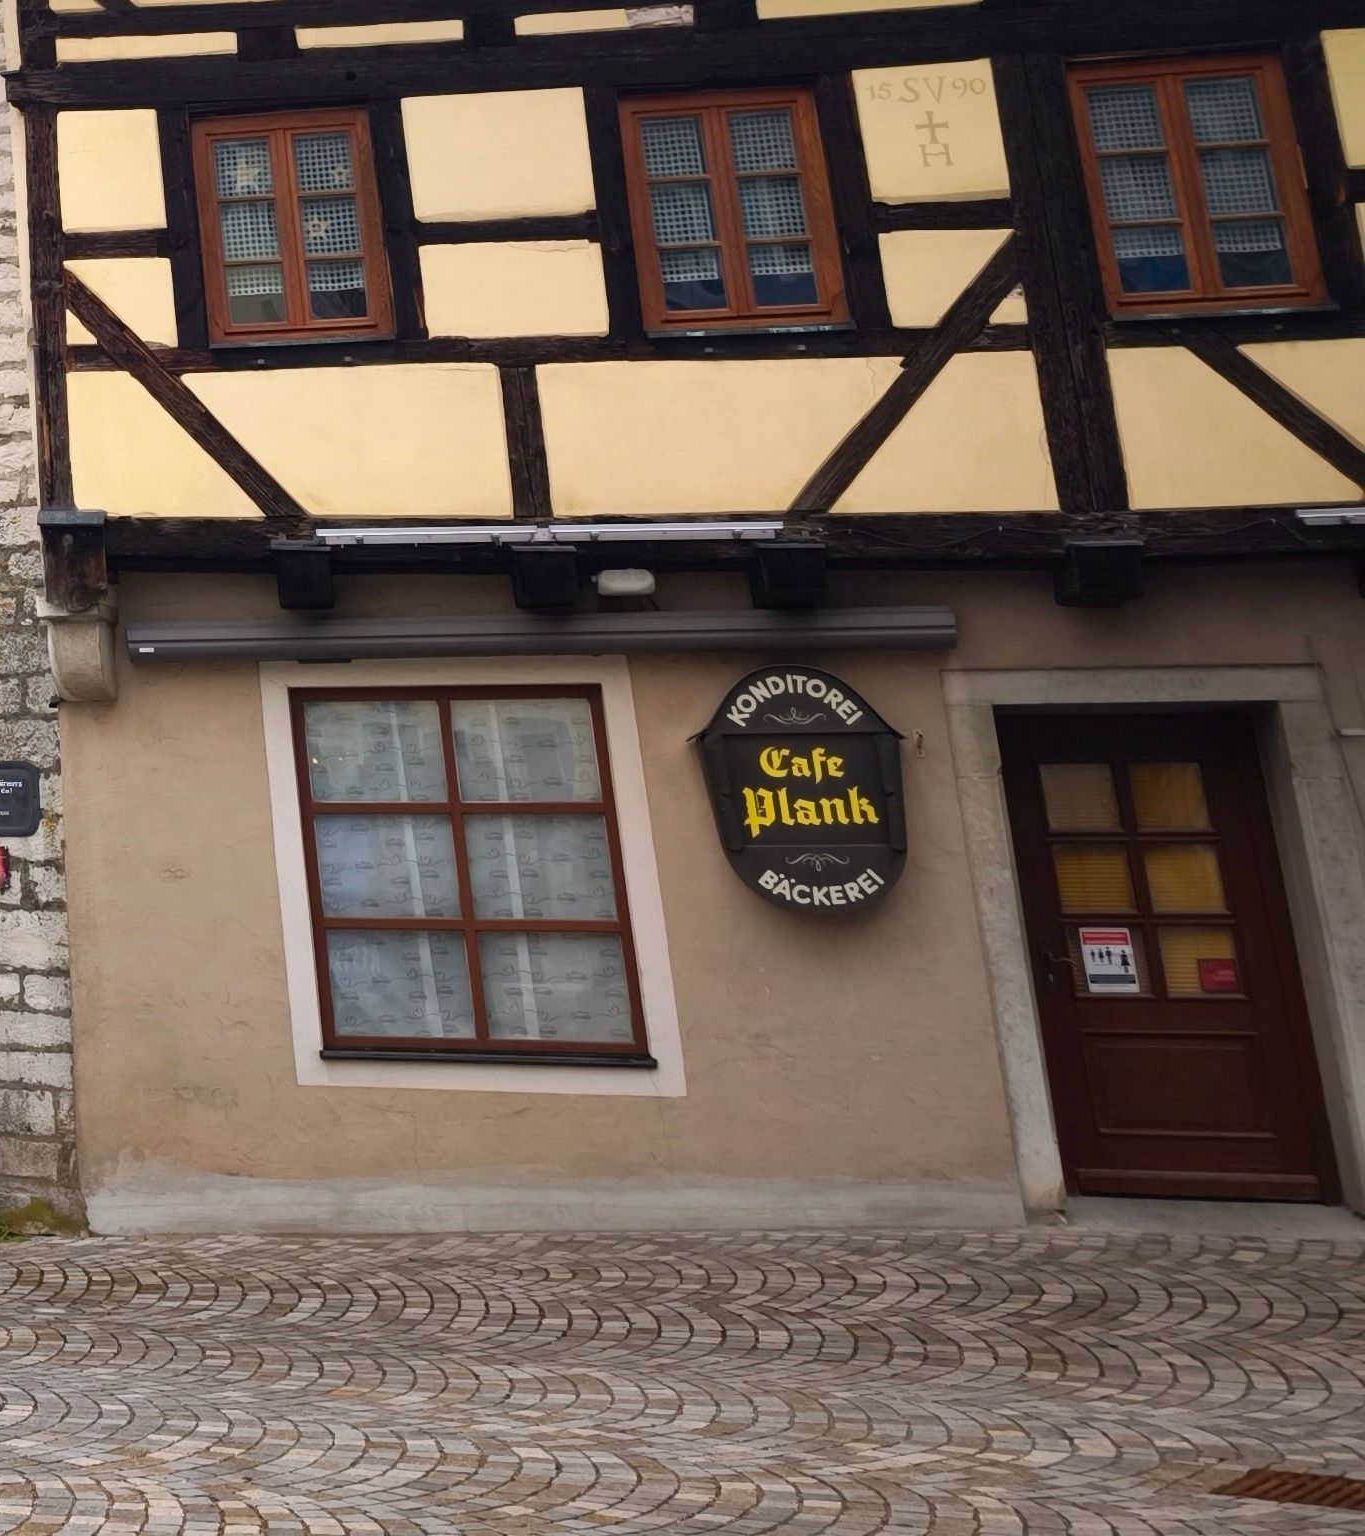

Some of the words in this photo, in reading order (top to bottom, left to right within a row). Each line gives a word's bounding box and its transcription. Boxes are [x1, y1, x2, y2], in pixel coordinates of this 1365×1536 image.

[866, 82, 893, 101] 15
[898, 76, 946, 104] SV
[951, 77, 987, 98] 90
[726, 674, 864, 727] KONDITOREI
[759, 746, 845, 784] Cafe
[741, 785, 880, 838] Plank
[757, 868, 885, 906] BÄCKEREI
